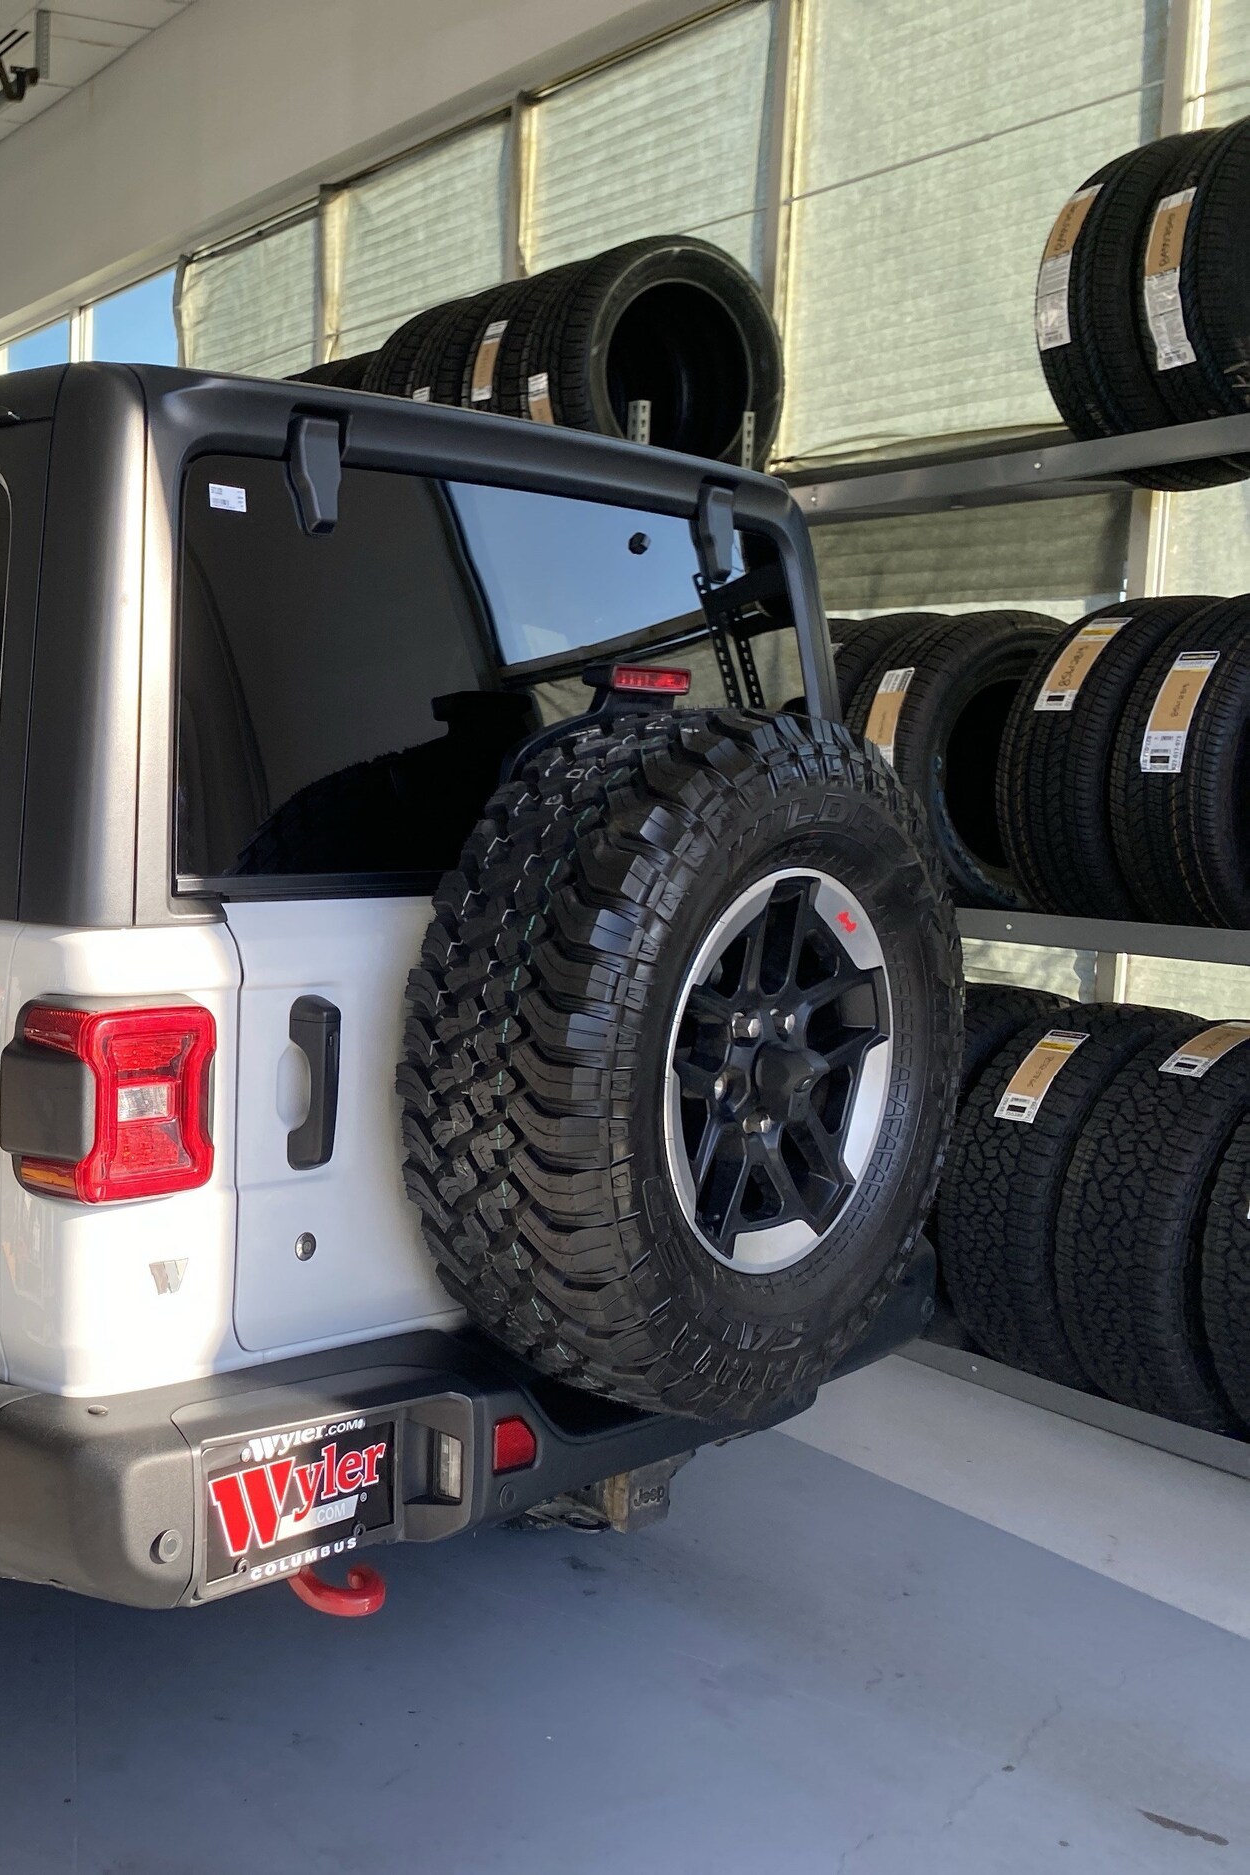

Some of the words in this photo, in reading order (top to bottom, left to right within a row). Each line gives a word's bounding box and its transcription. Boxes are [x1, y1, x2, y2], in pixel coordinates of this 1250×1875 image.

[209, 1443, 386, 1557] Wyler
[634, 1486, 664, 1507] Jeep
[250, 1537, 357, 1580] COLUMBUS
